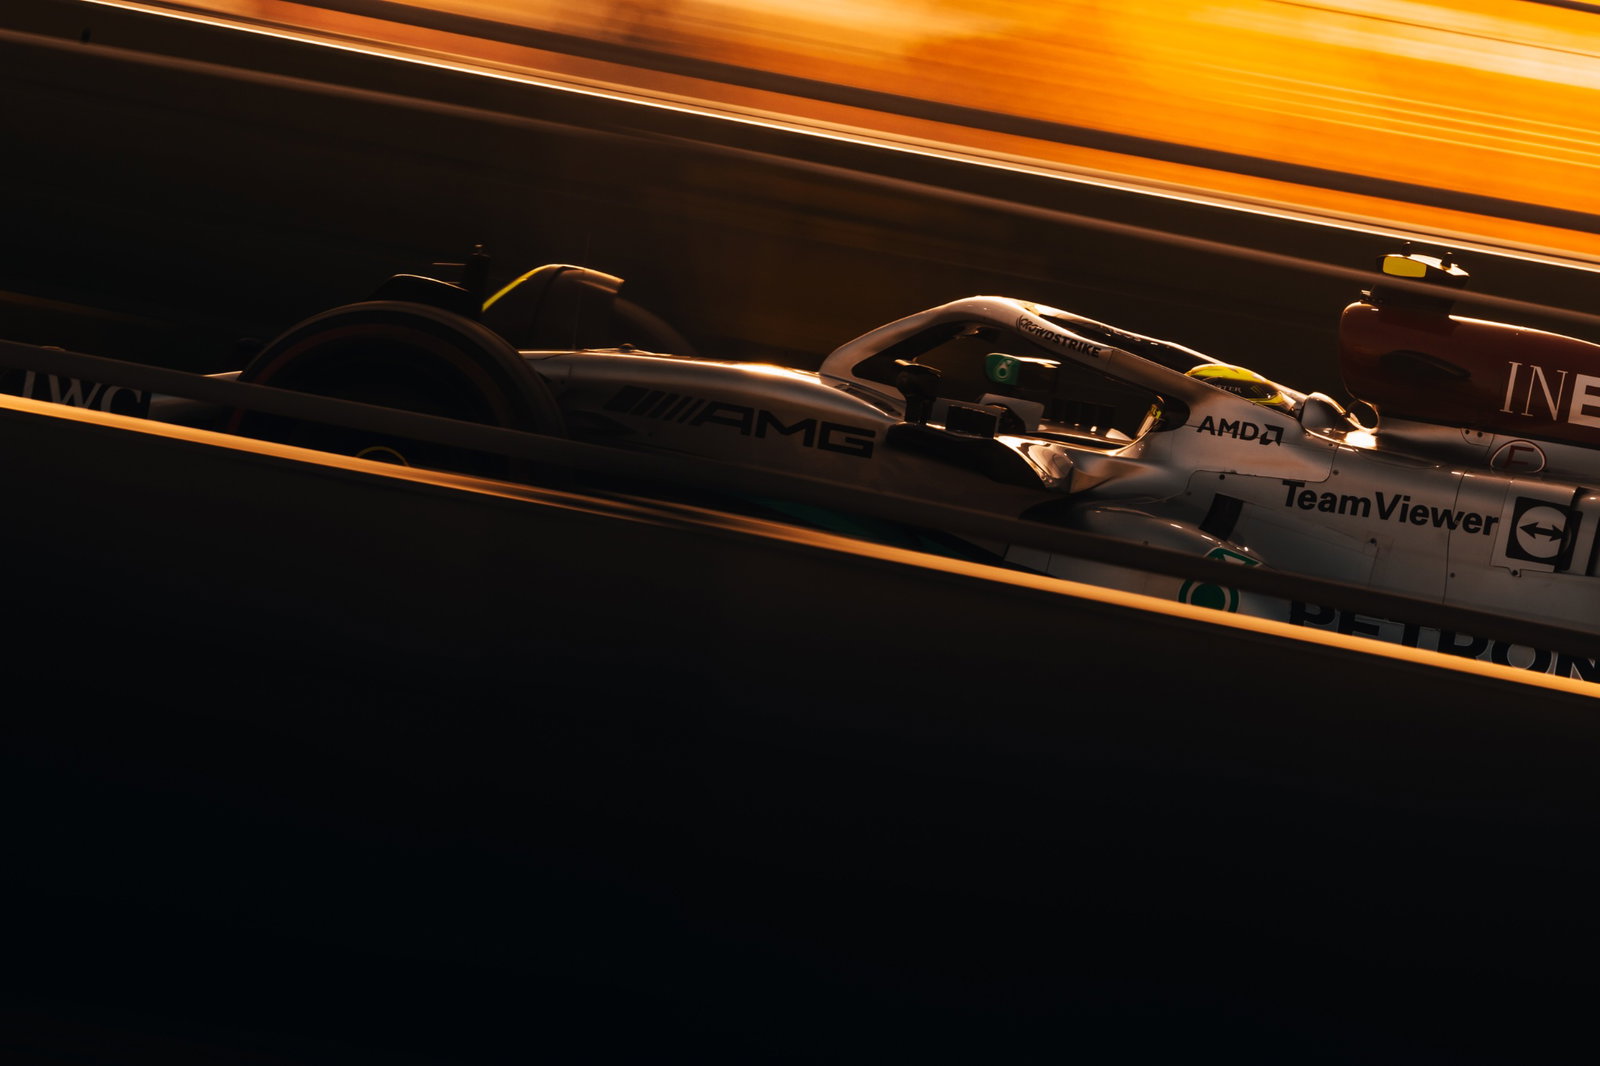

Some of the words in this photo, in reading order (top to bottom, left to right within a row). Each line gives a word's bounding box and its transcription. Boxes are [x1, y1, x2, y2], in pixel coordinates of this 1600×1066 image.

[1018, 317, 1102, 358] CROWDSTRIKE
[1499, 360, 1600, 429] INE
[688, 401, 876, 459] AMG
[1197, 415, 1259, 441] AMD
[1282, 479, 1499, 536] TeamViewer
